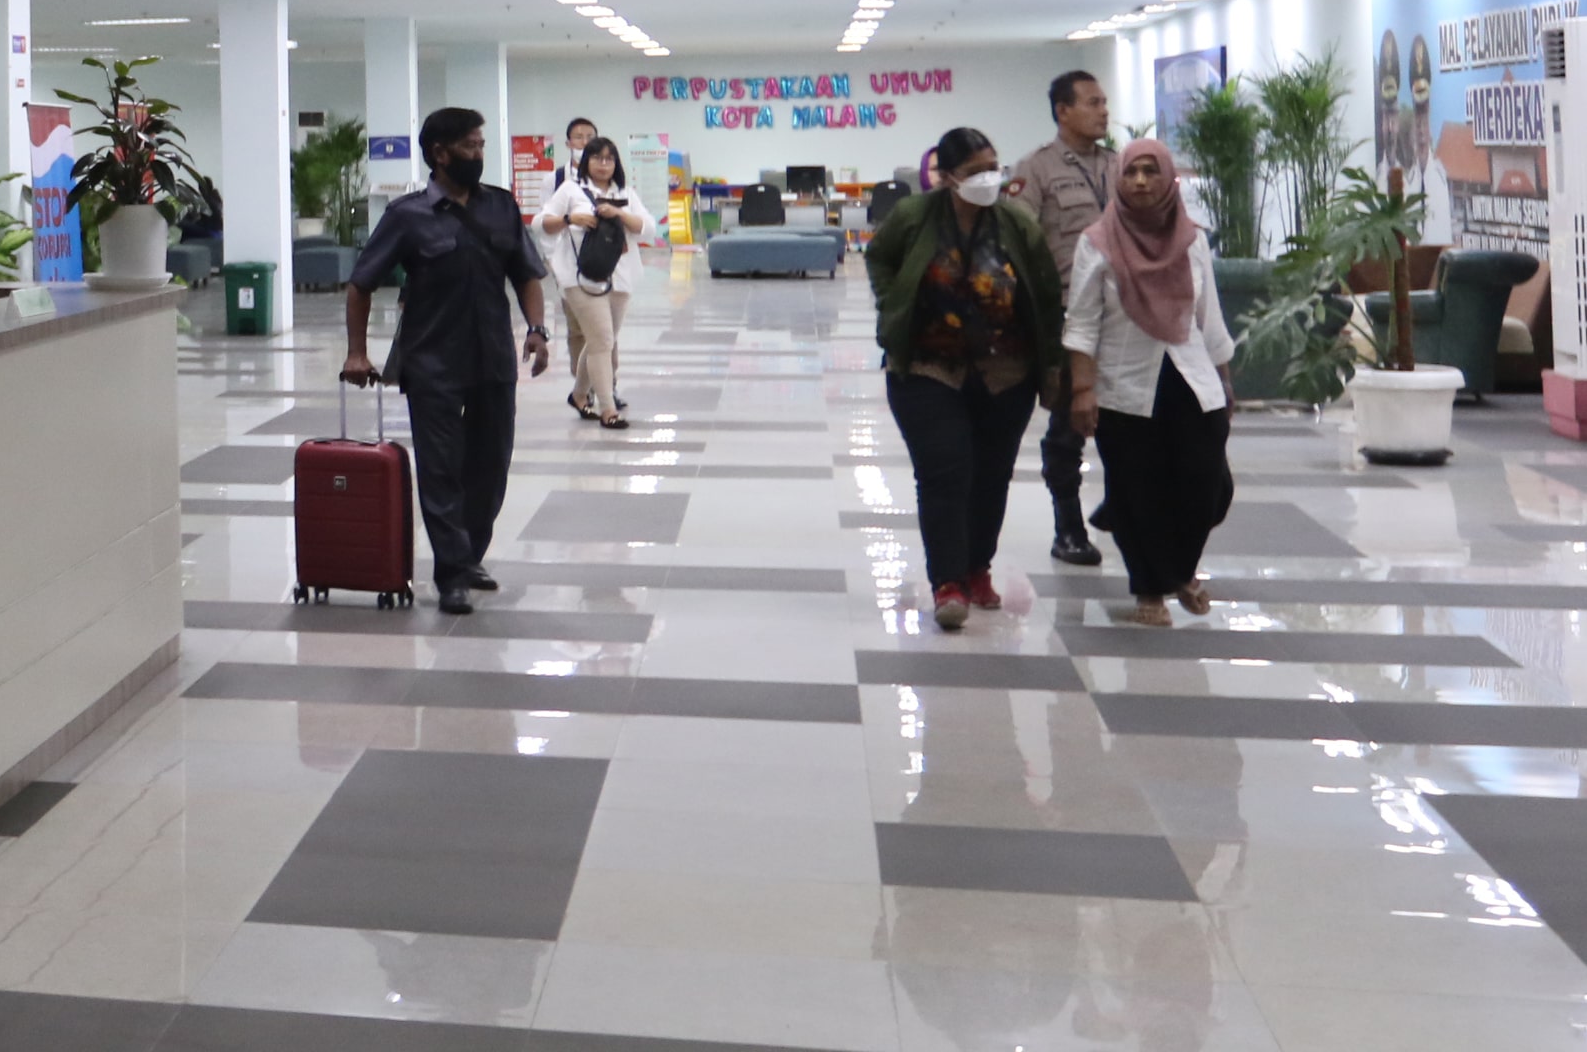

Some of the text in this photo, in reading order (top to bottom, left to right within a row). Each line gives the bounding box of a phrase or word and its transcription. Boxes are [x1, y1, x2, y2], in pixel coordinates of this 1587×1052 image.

[1439, 22, 1461, 65] MAL
[1464, 10, 1528, 61] PELAYANAN
[633, 74, 851, 100] PERPUSTAKAAN
[705, 103, 896, 129] KOTA MALANG
